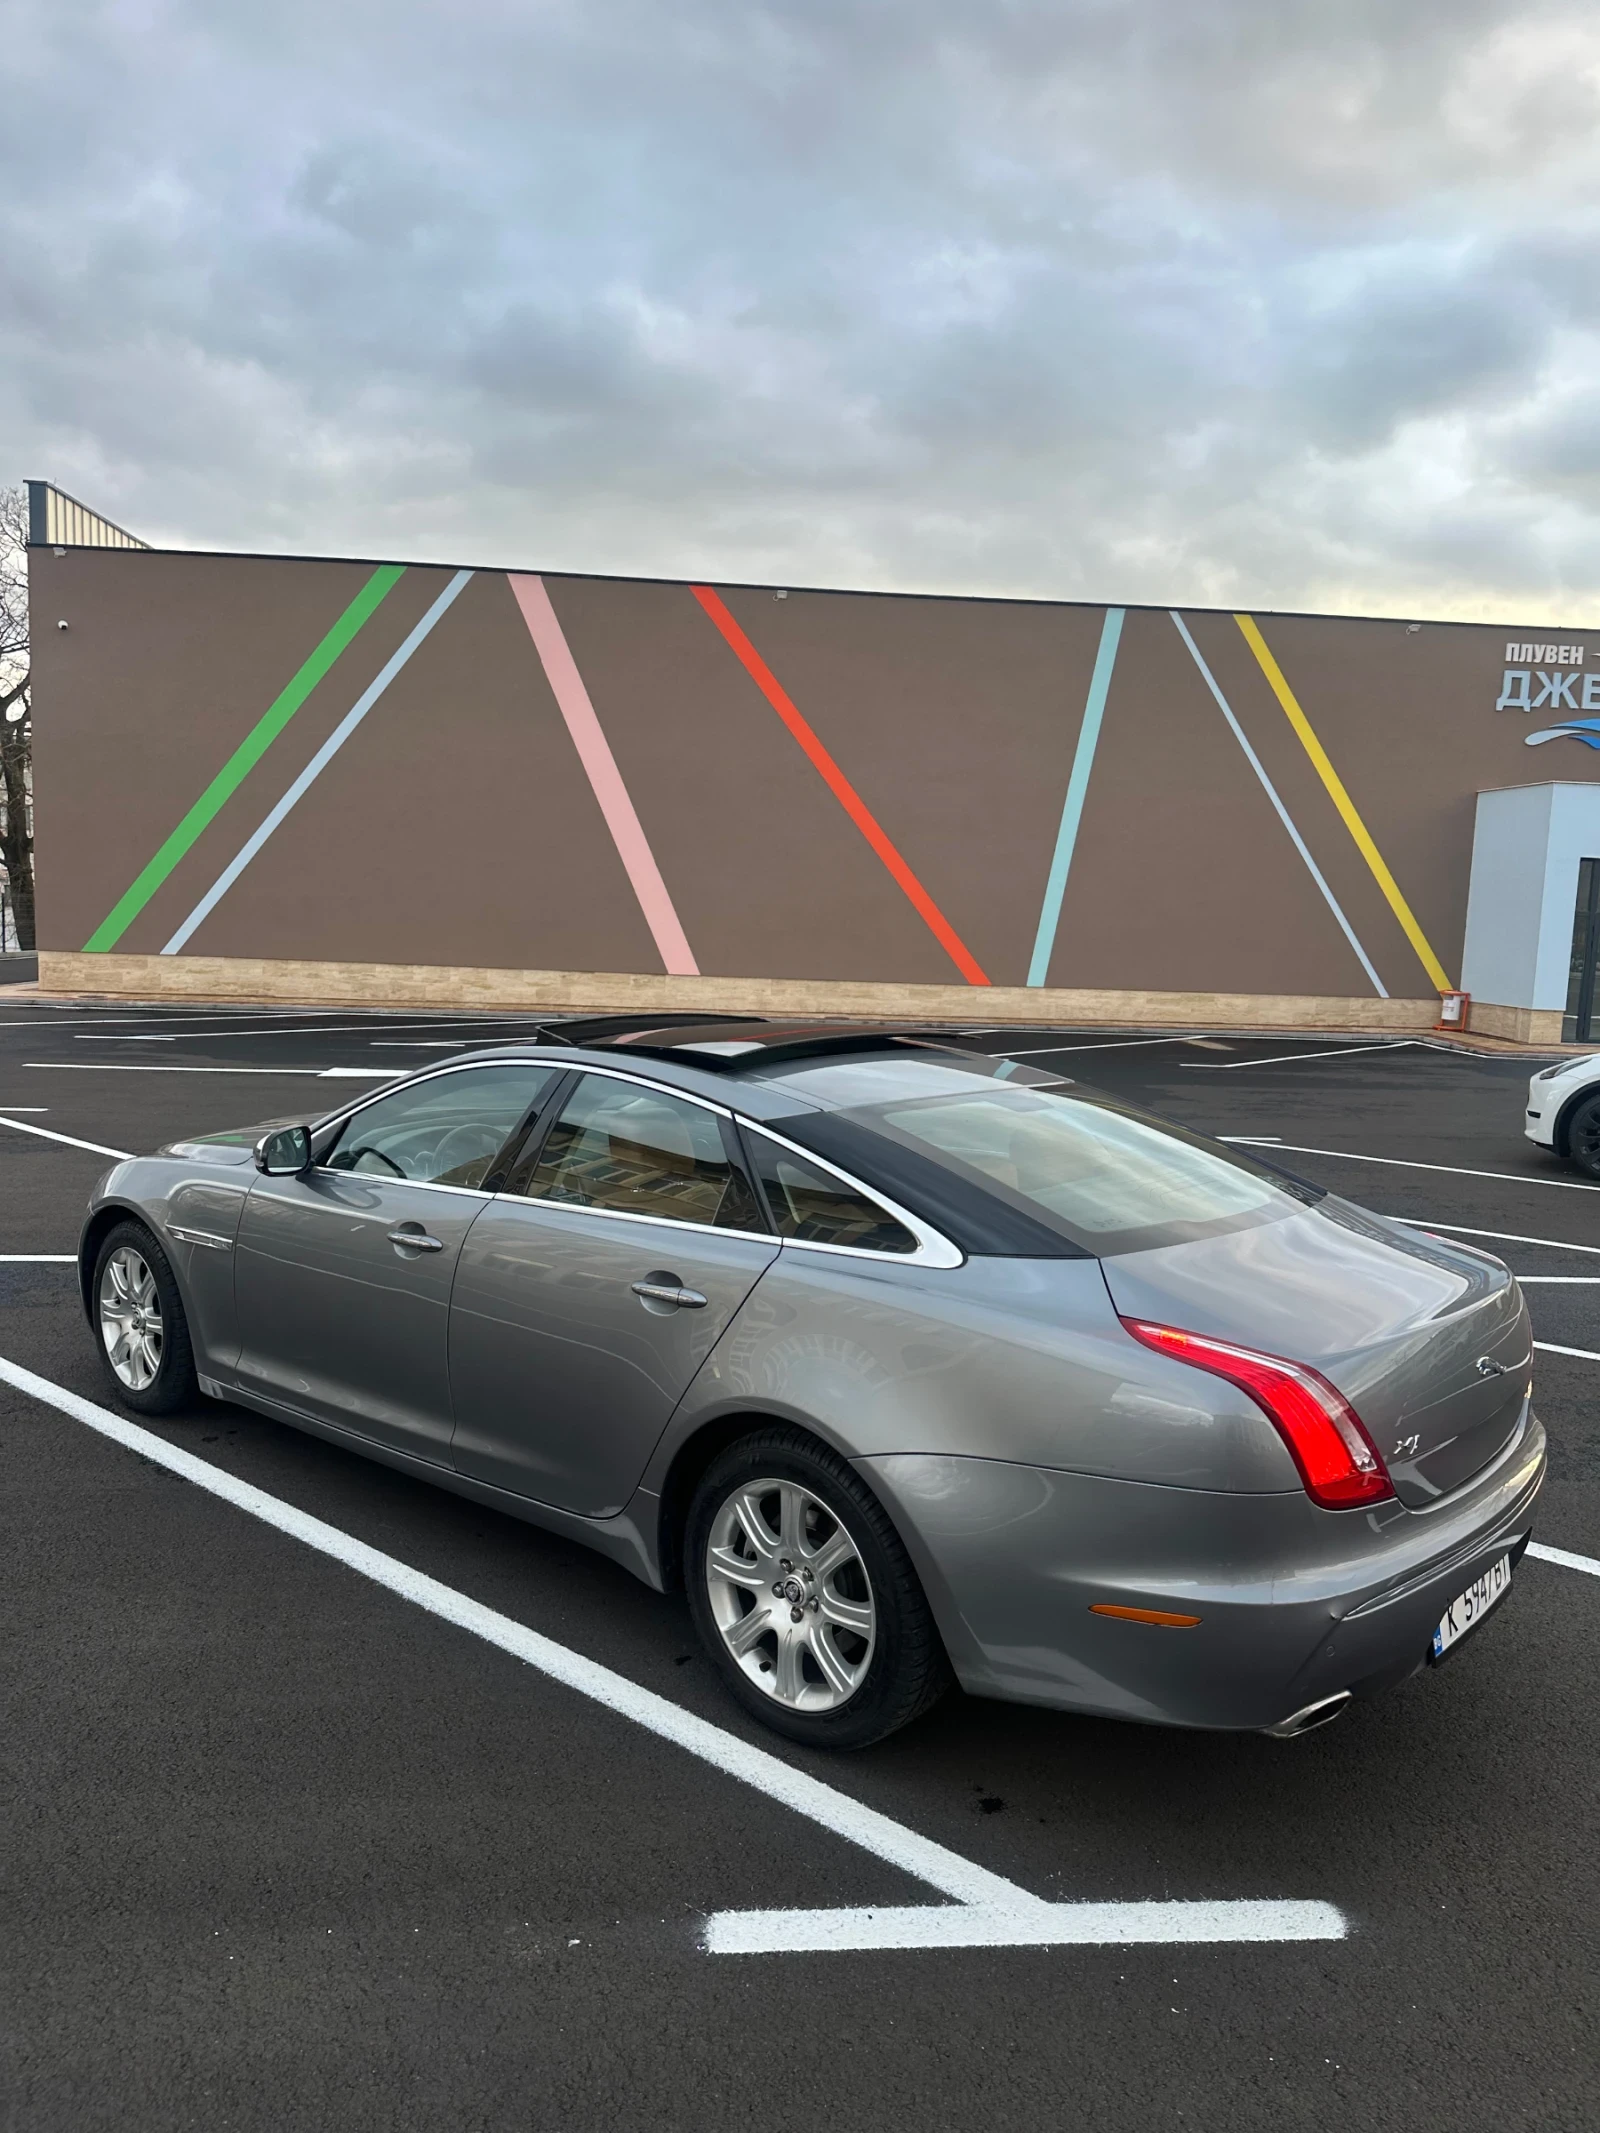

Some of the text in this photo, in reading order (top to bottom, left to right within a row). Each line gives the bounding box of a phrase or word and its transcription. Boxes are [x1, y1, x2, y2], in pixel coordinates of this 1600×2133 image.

[1505, 643, 1584, 665] ПЛУВЕН
[1496, 670, 1600, 712] ДЖЕ
[1447, 1604, 1458, 1637] K
